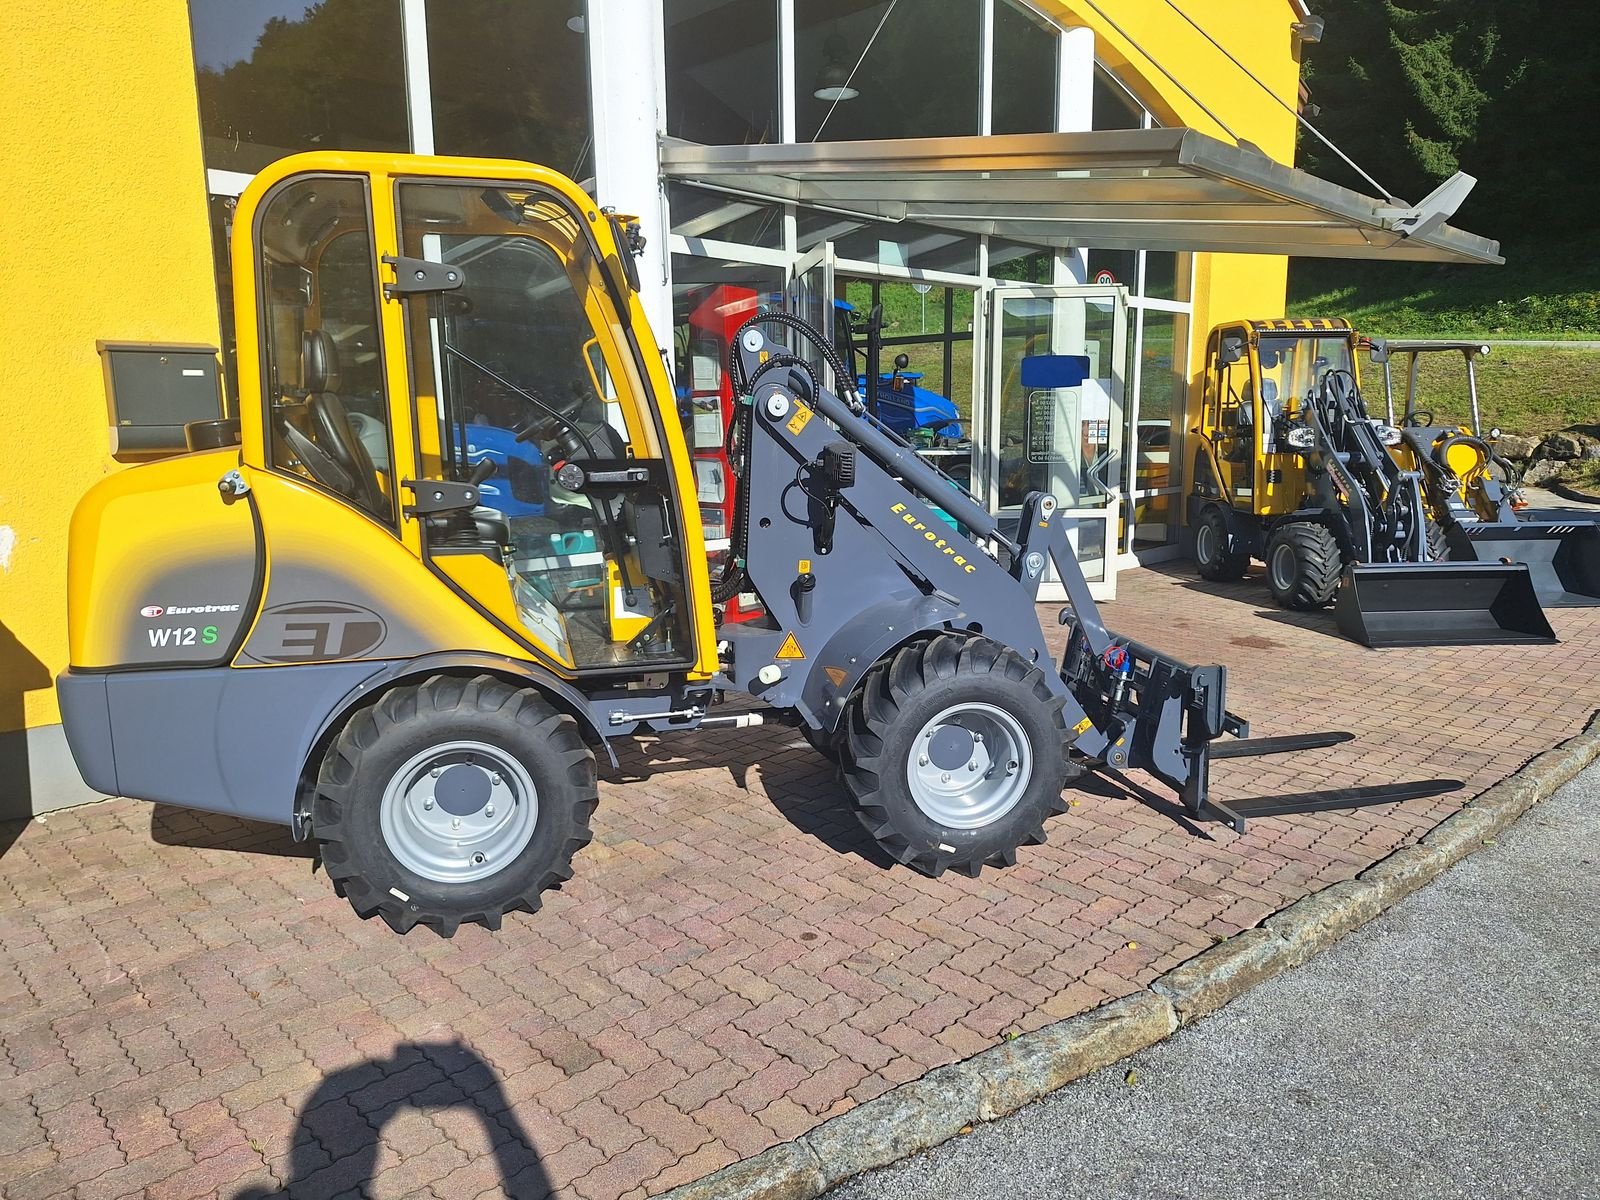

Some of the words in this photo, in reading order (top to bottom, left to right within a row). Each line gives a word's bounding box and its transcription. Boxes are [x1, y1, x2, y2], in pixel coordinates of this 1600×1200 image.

[890, 502, 976, 573] Eurotrac
[166, 604, 240, 615] Eurotrac
[148, 627, 197, 648] W12
[202, 625, 218, 644] S
